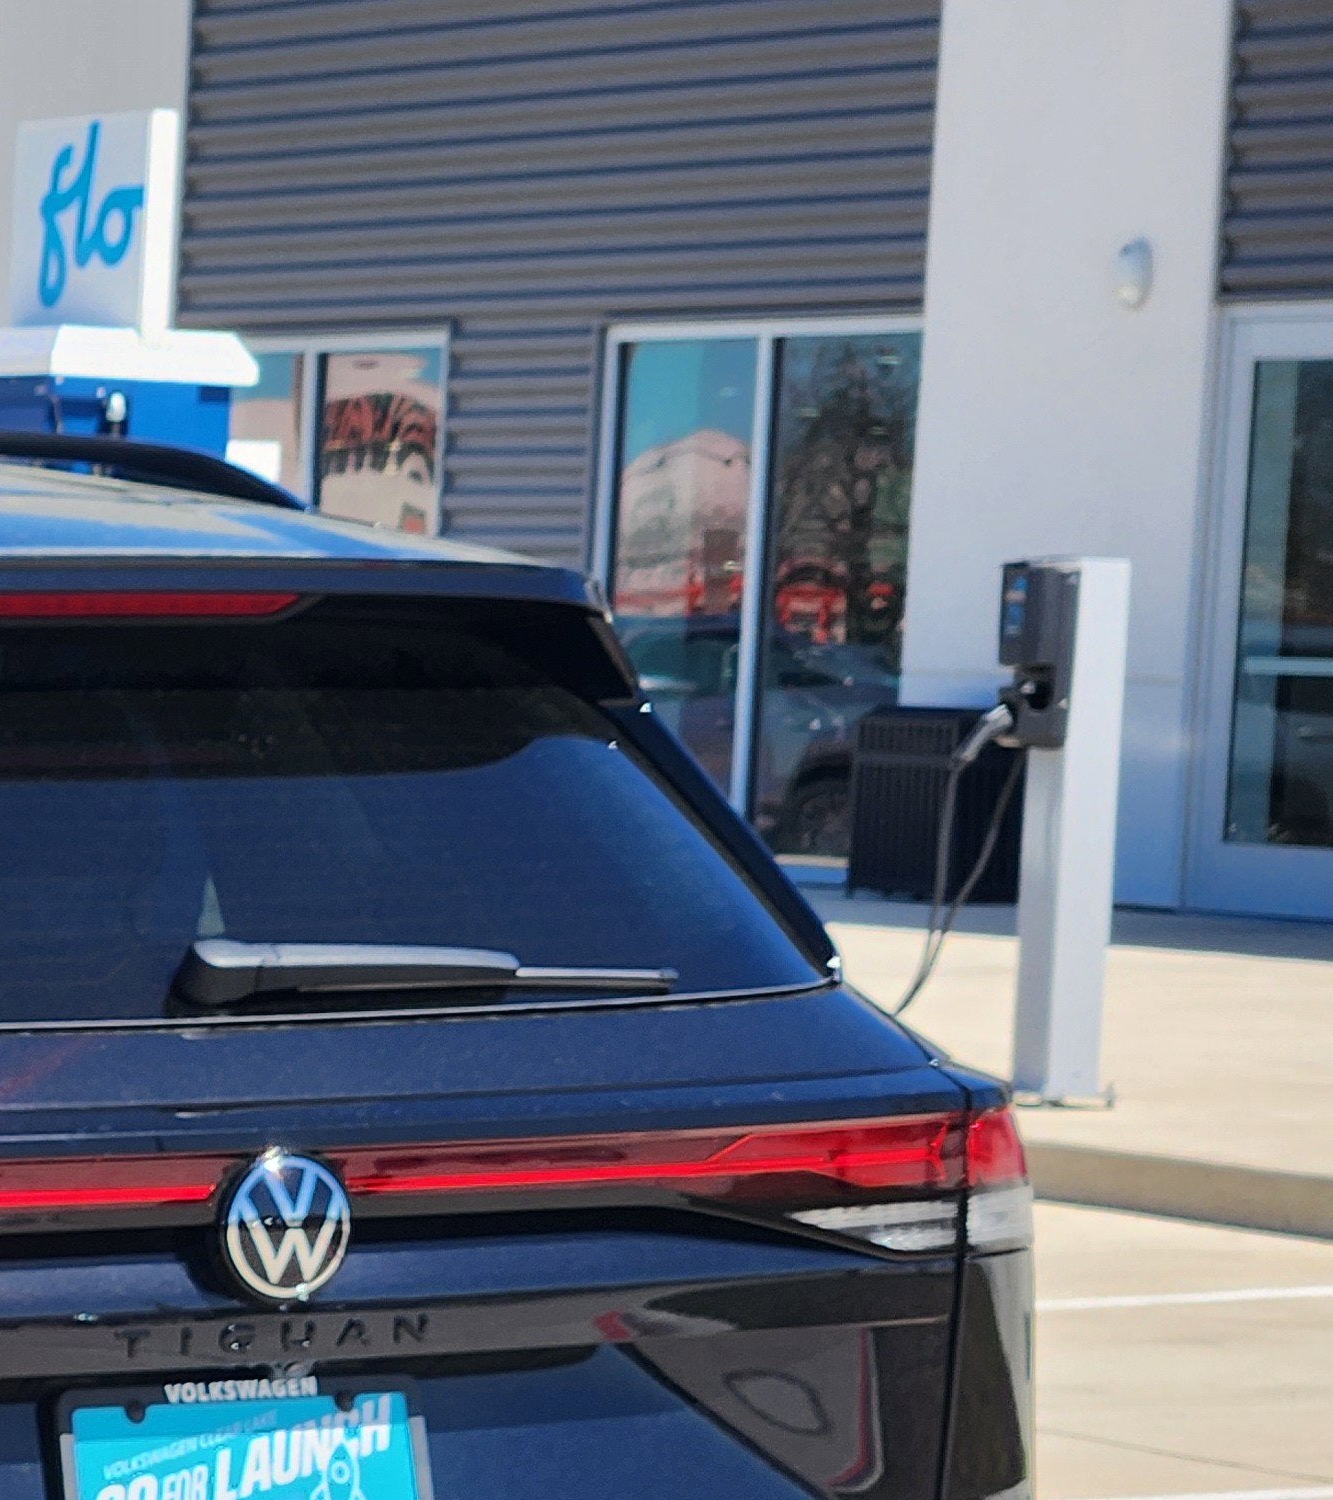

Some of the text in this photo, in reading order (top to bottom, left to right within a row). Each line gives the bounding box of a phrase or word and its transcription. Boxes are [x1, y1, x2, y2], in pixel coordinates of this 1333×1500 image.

[40, 120, 144, 308] flo
[229, 1156, 348, 1297] VW
[113, 1313, 431, 1357] TIGUAN
[164, 1376, 318, 1405] VOLKSWAGEN
